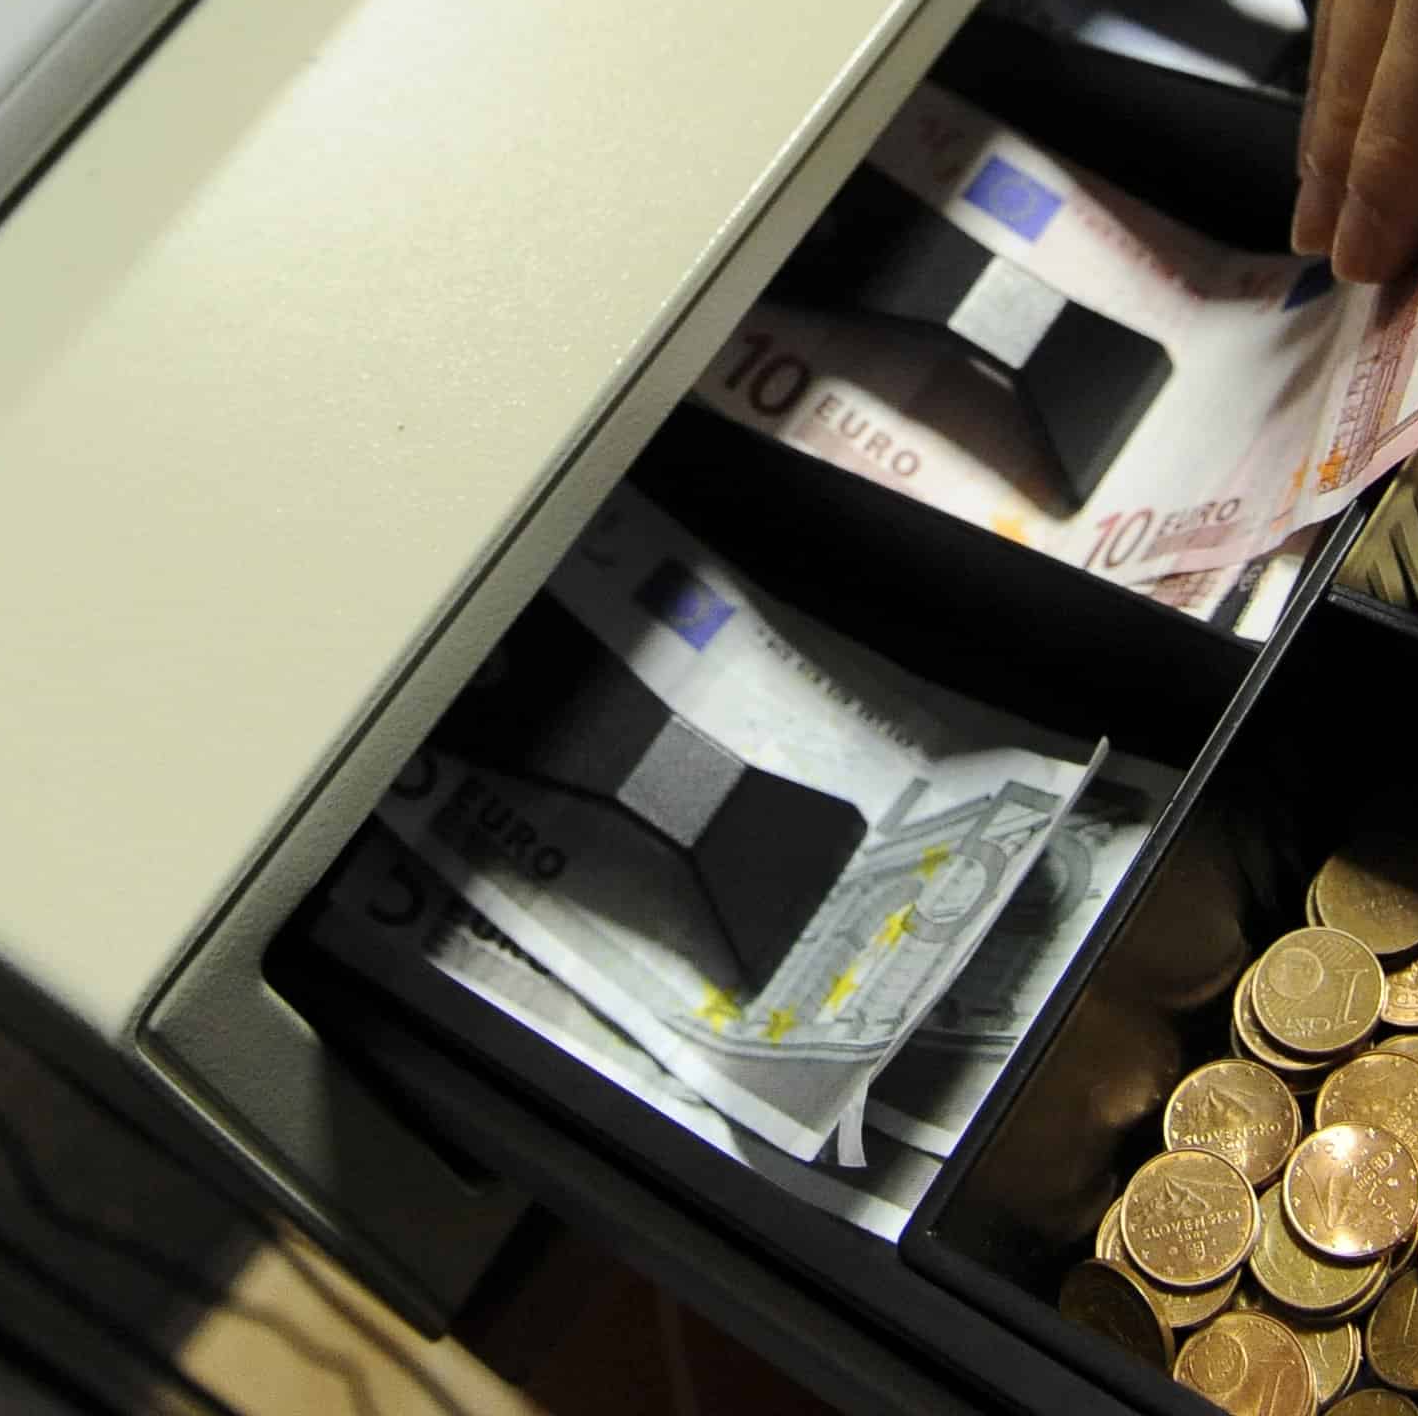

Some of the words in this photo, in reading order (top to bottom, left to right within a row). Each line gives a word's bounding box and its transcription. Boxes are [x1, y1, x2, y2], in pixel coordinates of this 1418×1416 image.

[724, 334, 813, 417] 10
[814, 391, 923, 477] EURO
[1084, 507, 1155, 569] 10
[1156, 496, 1242, 536] EURO
[454, 776, 569, 881] EURO
[1141, 1209, 1241, 1240] SLOVENSKO
